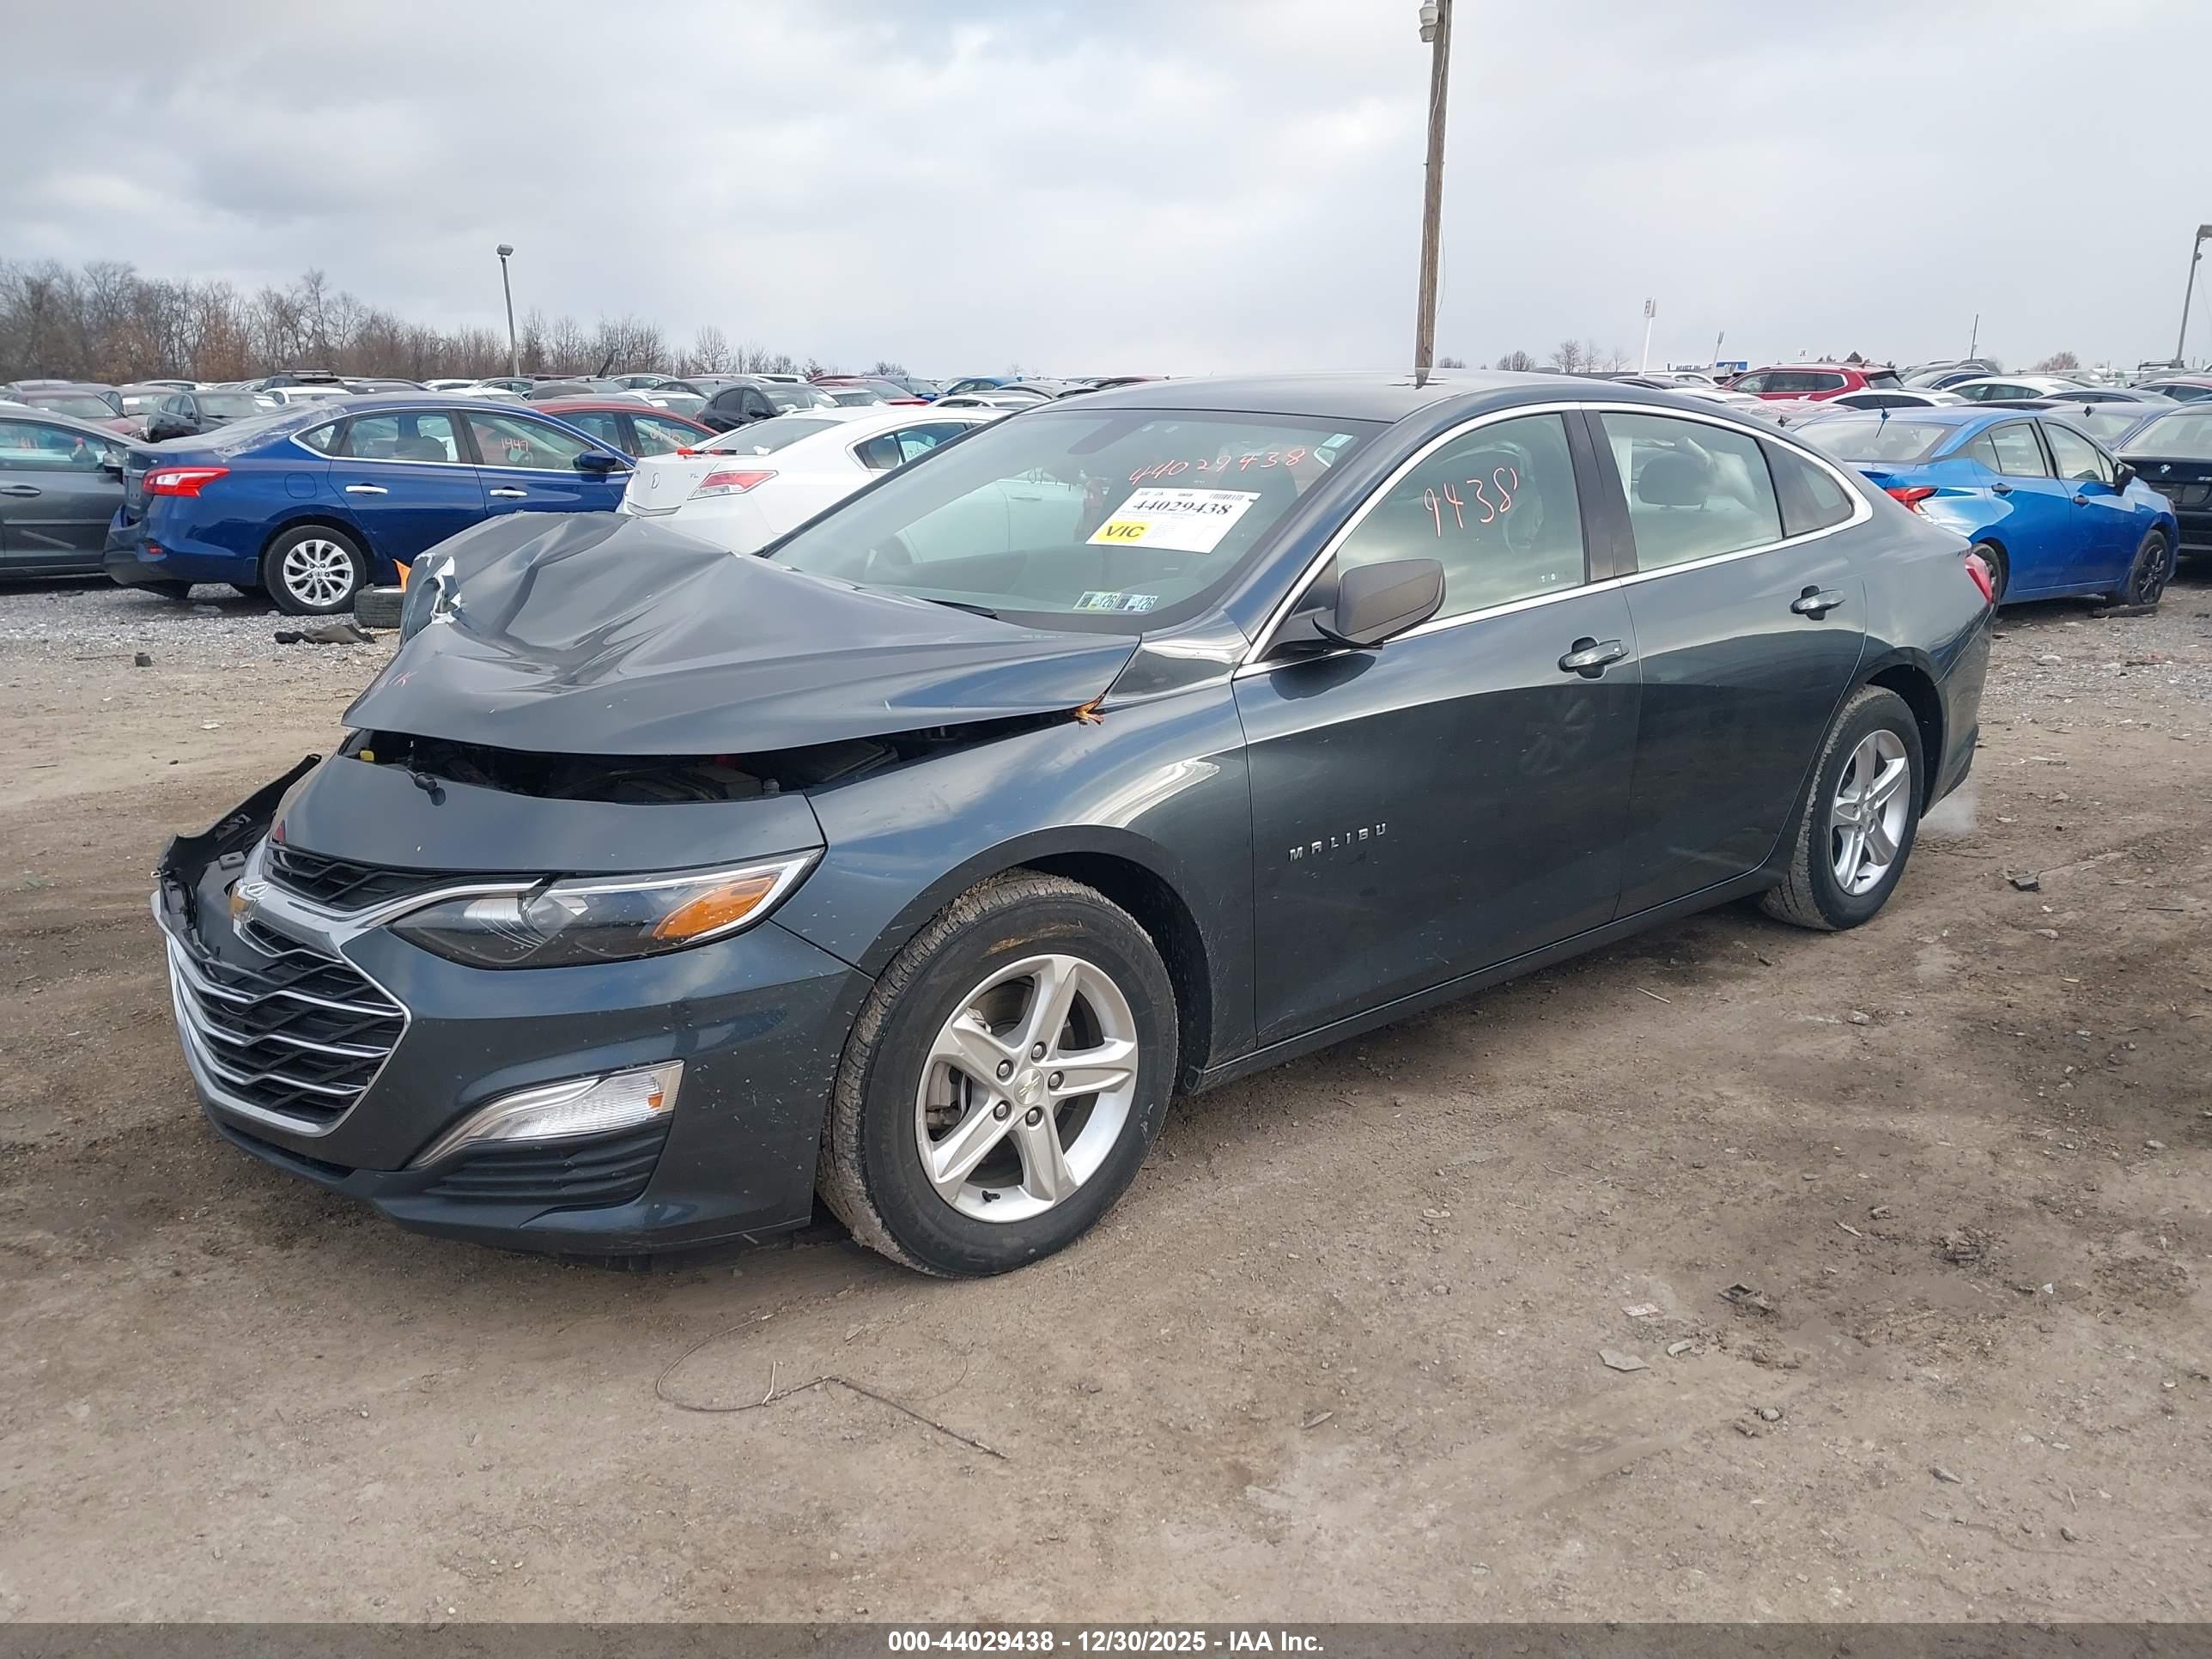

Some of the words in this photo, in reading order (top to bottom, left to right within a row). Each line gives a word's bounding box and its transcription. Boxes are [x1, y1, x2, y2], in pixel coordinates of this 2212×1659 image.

[1133, 500, 1232, 516] 44029438
[1424, 467, 1518, 538] 9438
[1105, 526, 1145, 538] VIC
[1289, 823, 1386, 861] MALIBU
